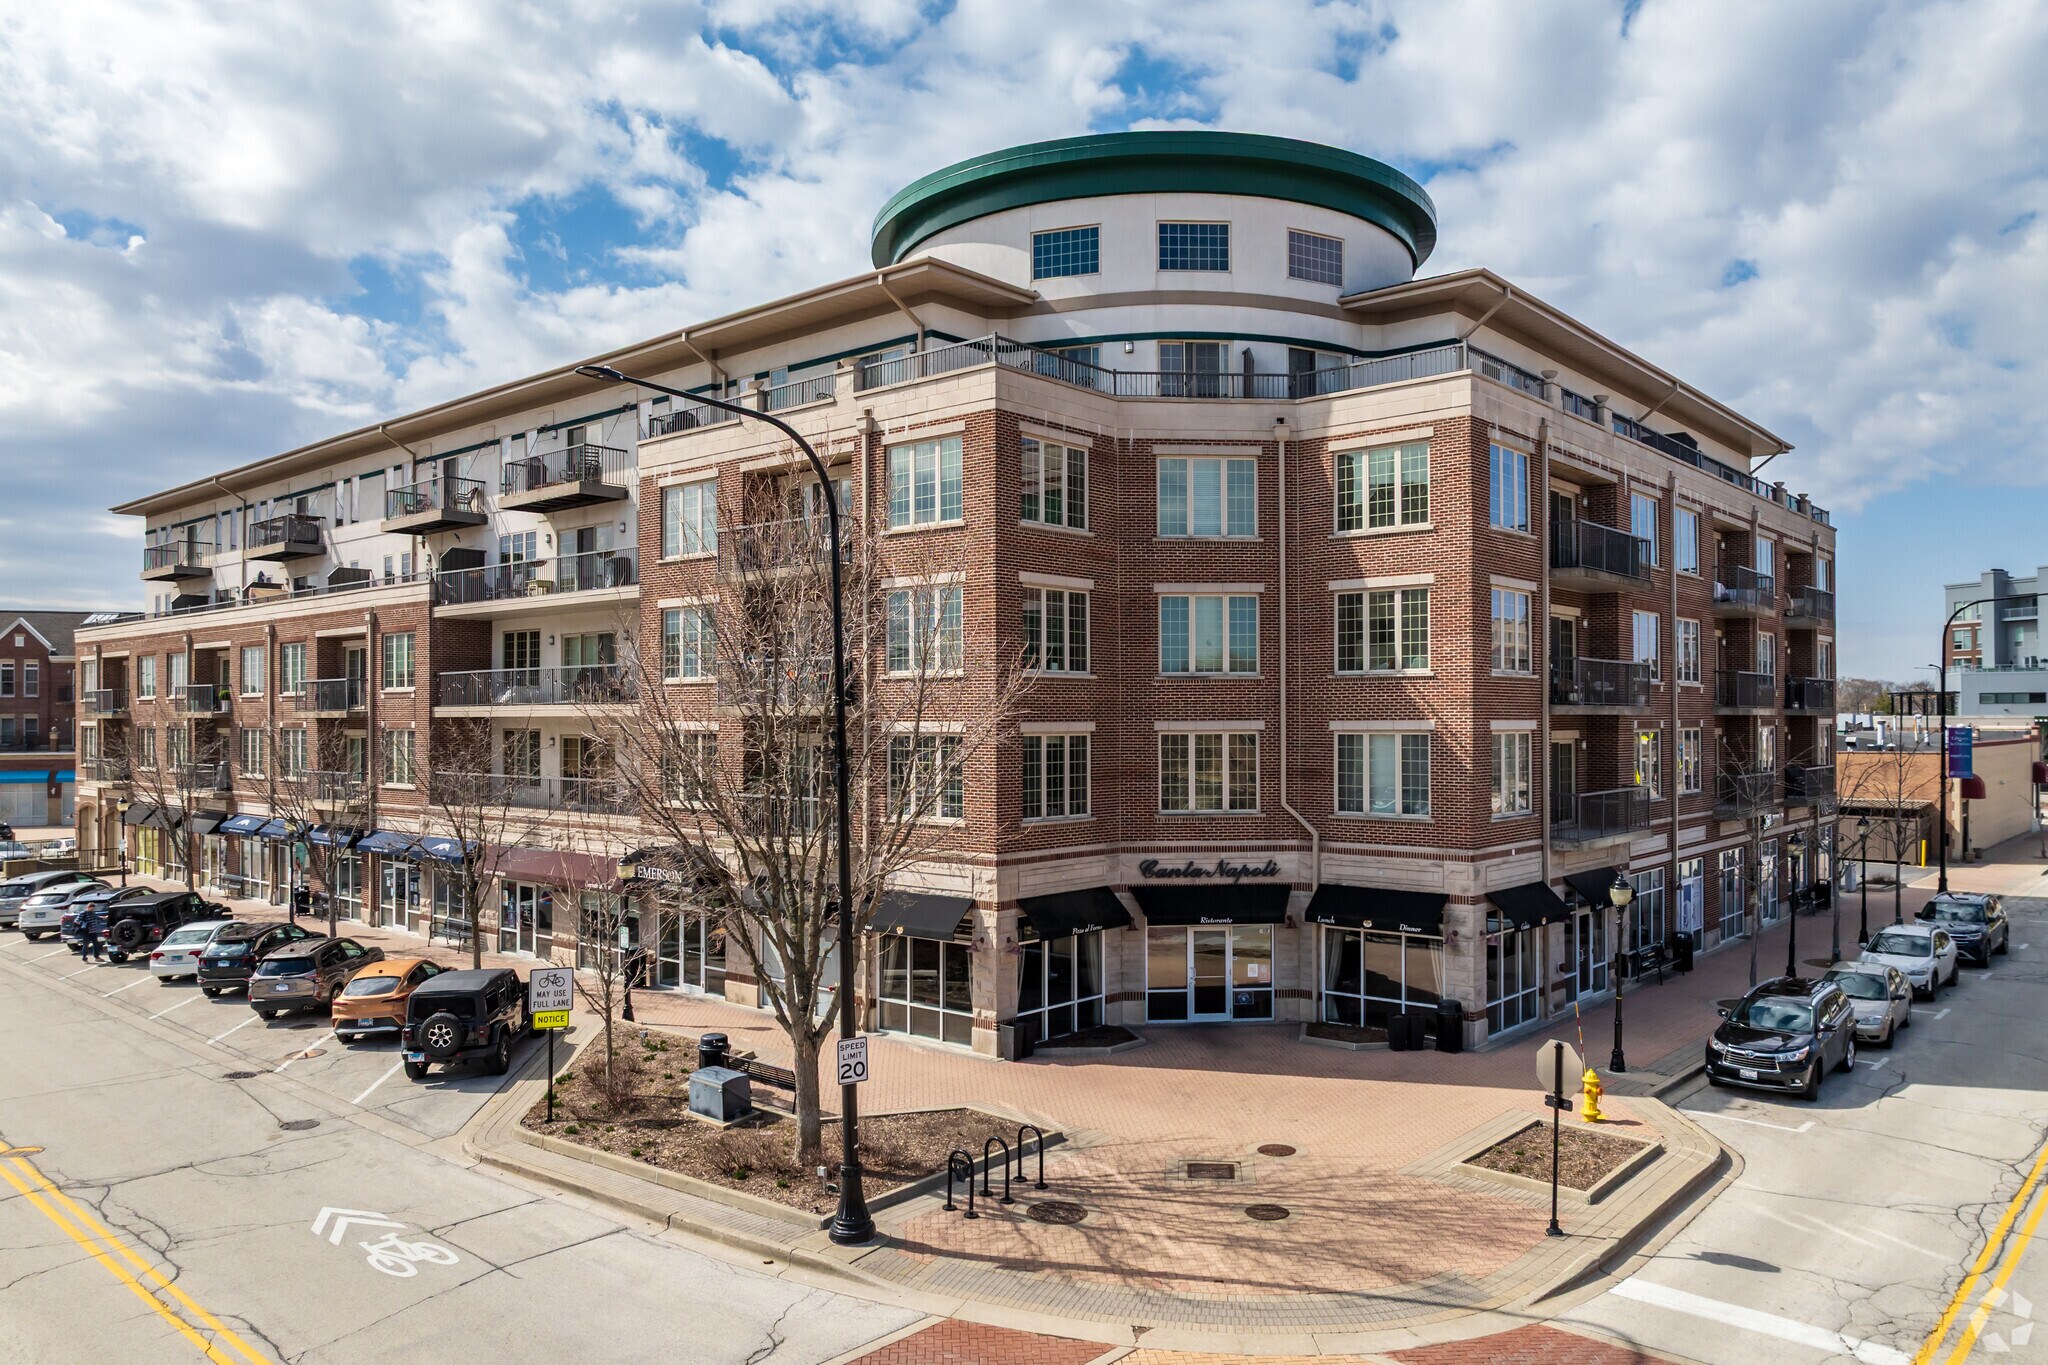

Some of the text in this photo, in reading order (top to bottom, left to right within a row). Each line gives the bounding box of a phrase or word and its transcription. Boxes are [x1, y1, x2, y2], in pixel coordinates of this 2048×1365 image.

[637, 866, 682, 883] EMERSON
[1139, 859, 1281, 884] Canta Napoli
[1200, 916, 1233, 924] Ristorante
[1317, 916, 1335, 924] Lunch
[1399, 923, 1421, 933] Dinner
[553, 989, 567, 997] USE
[553, 999, 570, 1007] LANE
[537, 1015, 565, 1023] NOTICE
[840, 1041, 865, 1051] SPEED
[842, 1051, 862, 1061] LIMIT
[840, 1060, 865, 1080] 20
